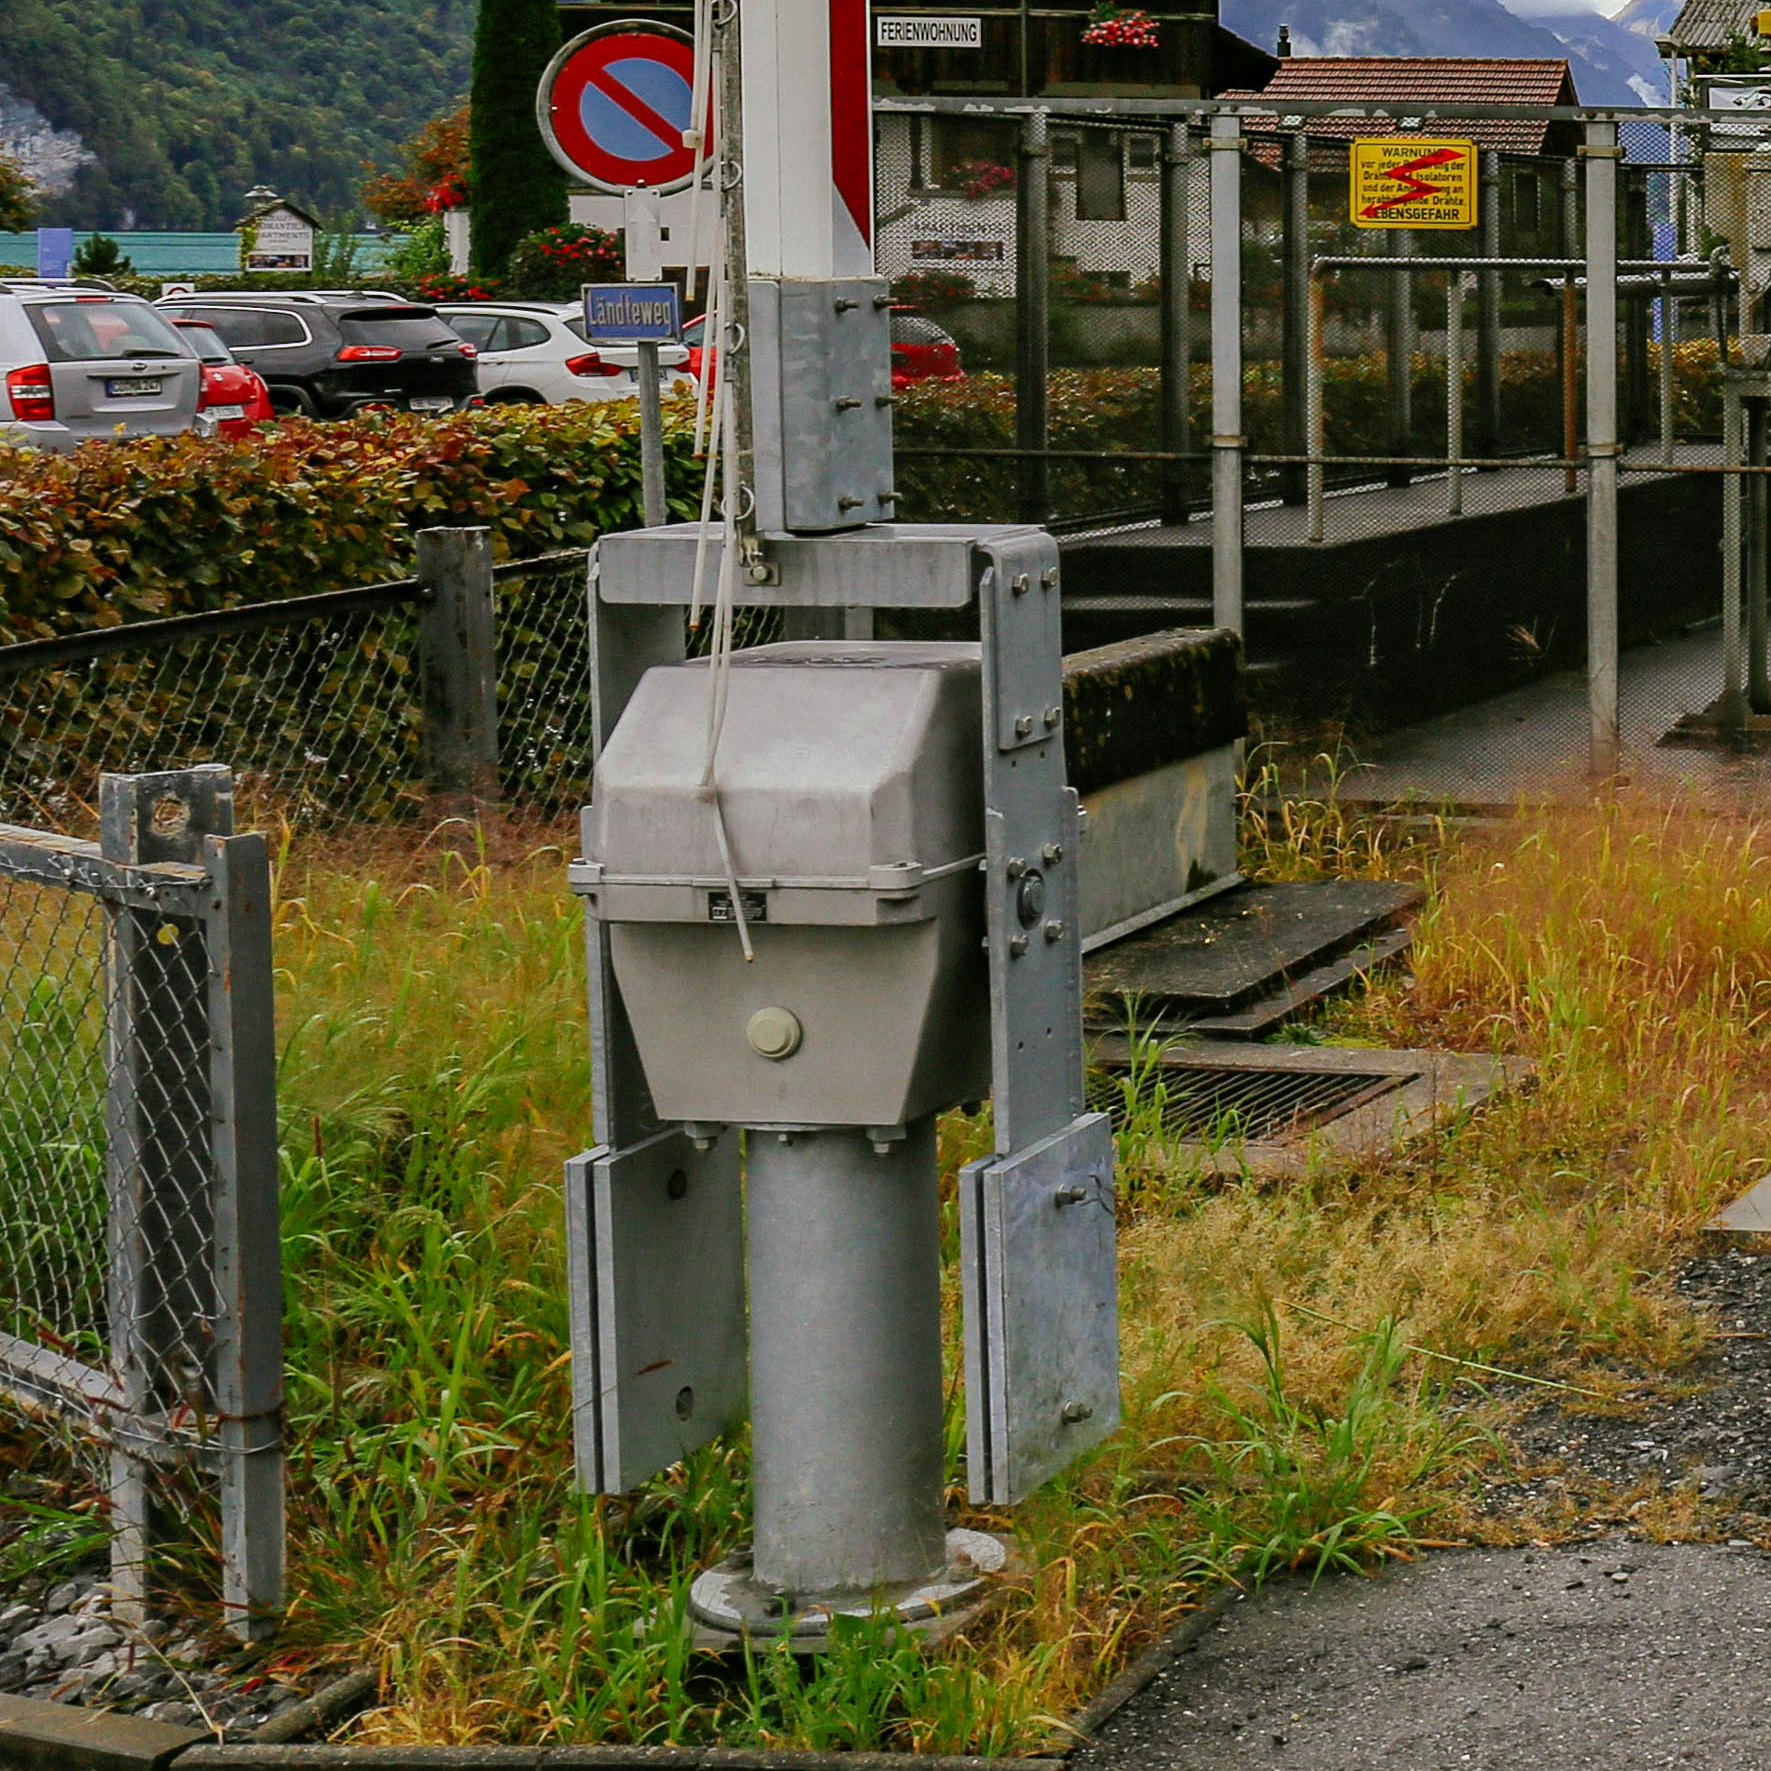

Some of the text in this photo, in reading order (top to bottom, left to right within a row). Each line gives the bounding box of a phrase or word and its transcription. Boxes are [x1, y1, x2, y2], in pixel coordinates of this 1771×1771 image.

[881, 22, 977, 42] FERIENWOHNUNG
[1382, 147, 1441, 158] WARNUN
[587, 289, 672, 336] Ländteweg
